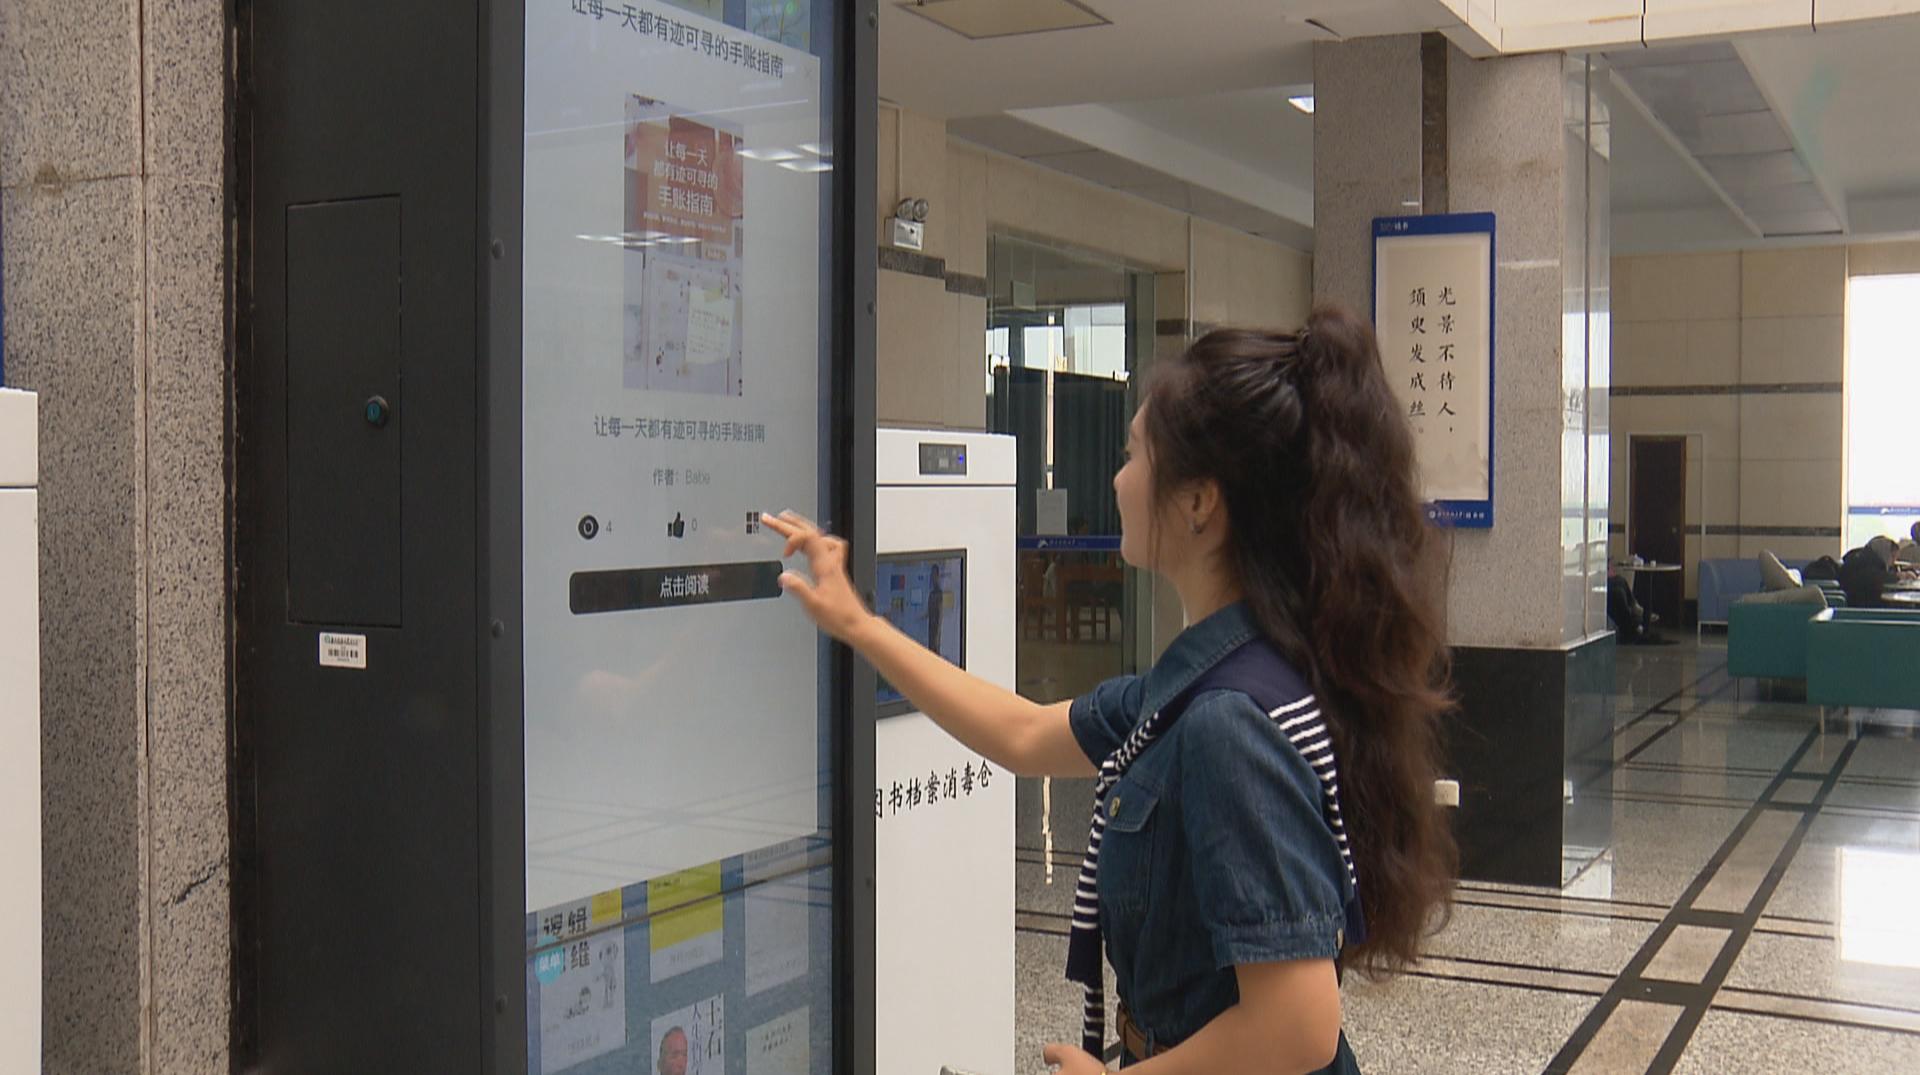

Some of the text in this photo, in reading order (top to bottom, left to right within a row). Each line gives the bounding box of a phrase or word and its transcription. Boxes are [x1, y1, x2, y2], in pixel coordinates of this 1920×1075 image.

[571, 0, 784, 79] 让每一天都有迹可寻的手账指南
[665, 140, 708, 168] 让每一天
[654, 160, 719, 191] 都有迹可寻的
[658, 185, 713, 217] 手账指南
[594, 415, 766, 443] 让每一天都有迹可寻的手账指南
[686, 469, 710, 485] Babe
[605, 520, 613, 534] 4
[691, 518, 698, 532] 0
[660, 573, 709, 598] 点击阅读
